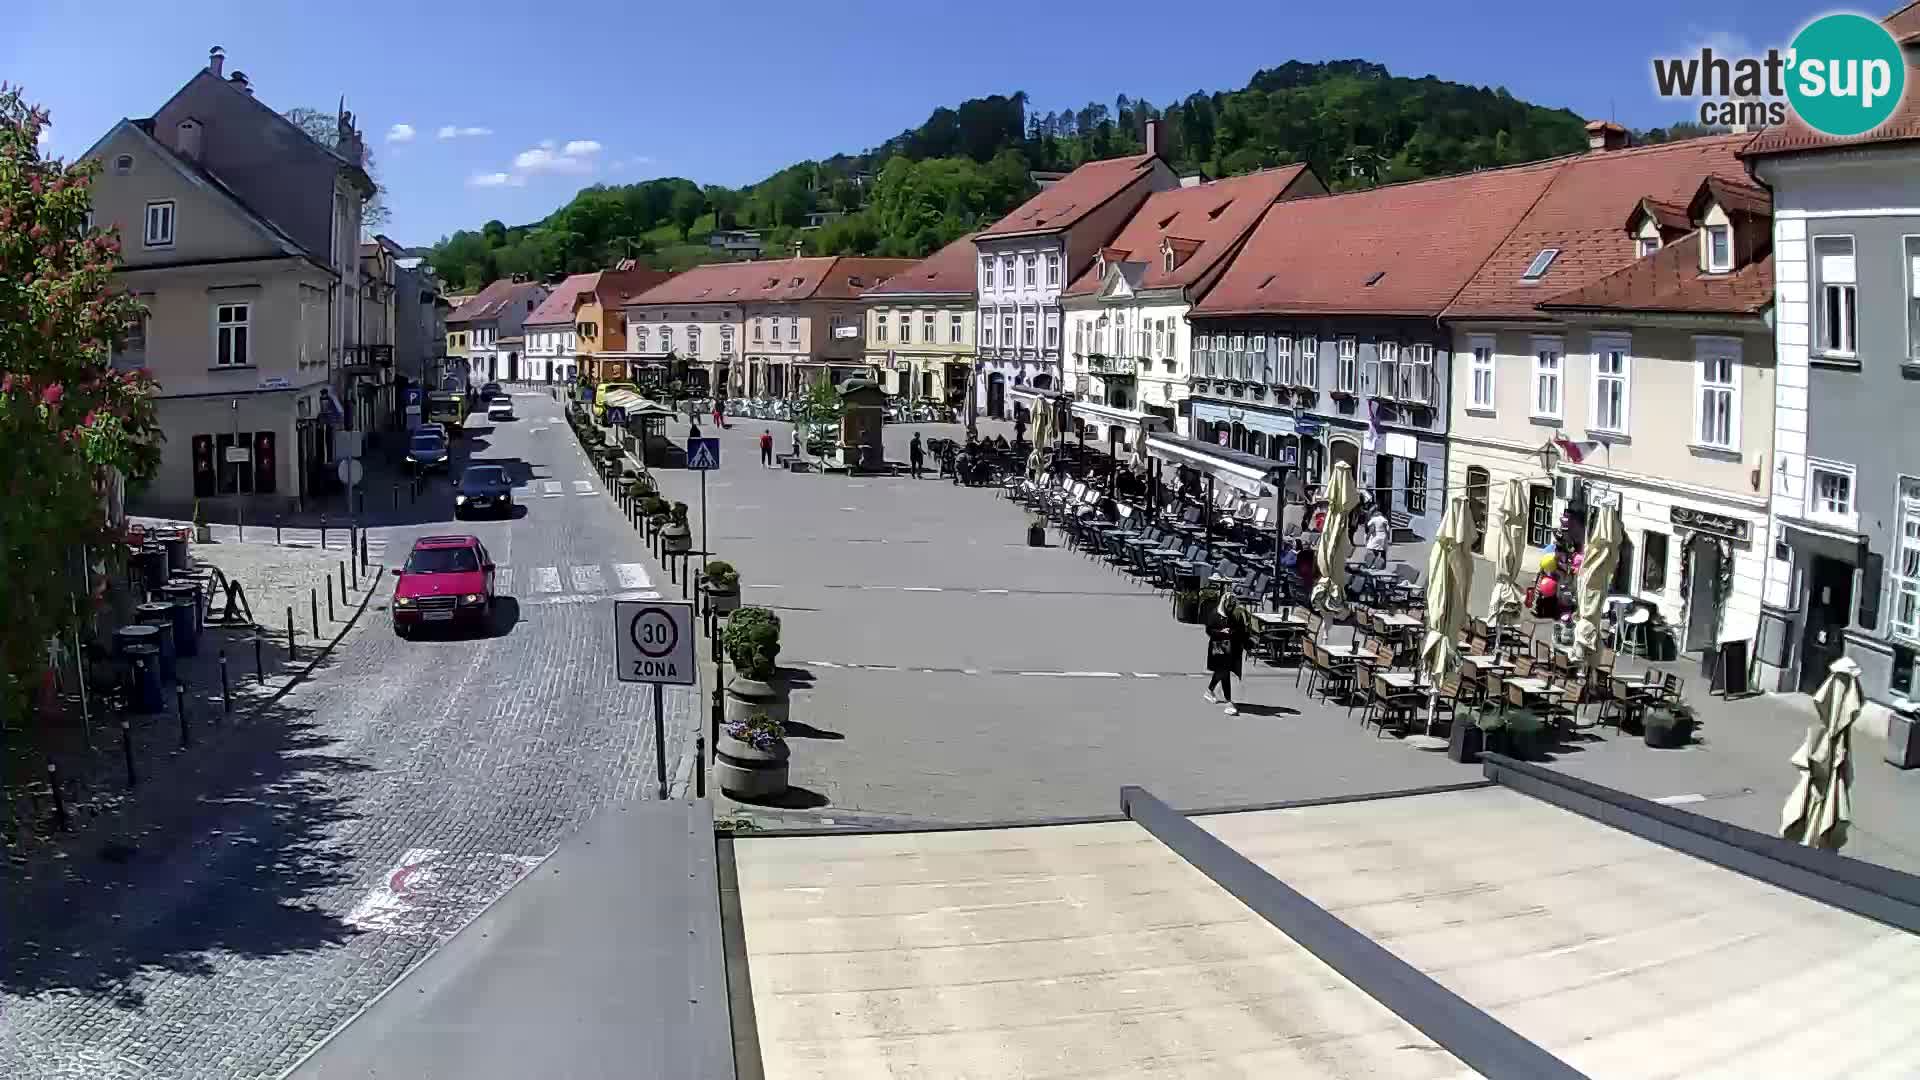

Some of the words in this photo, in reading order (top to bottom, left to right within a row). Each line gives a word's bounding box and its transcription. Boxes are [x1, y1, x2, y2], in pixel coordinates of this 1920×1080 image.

[410, 392, 417, 404] P
[643, 623, 667, 644] 30
[633, 660, 677, 677] ZONA
